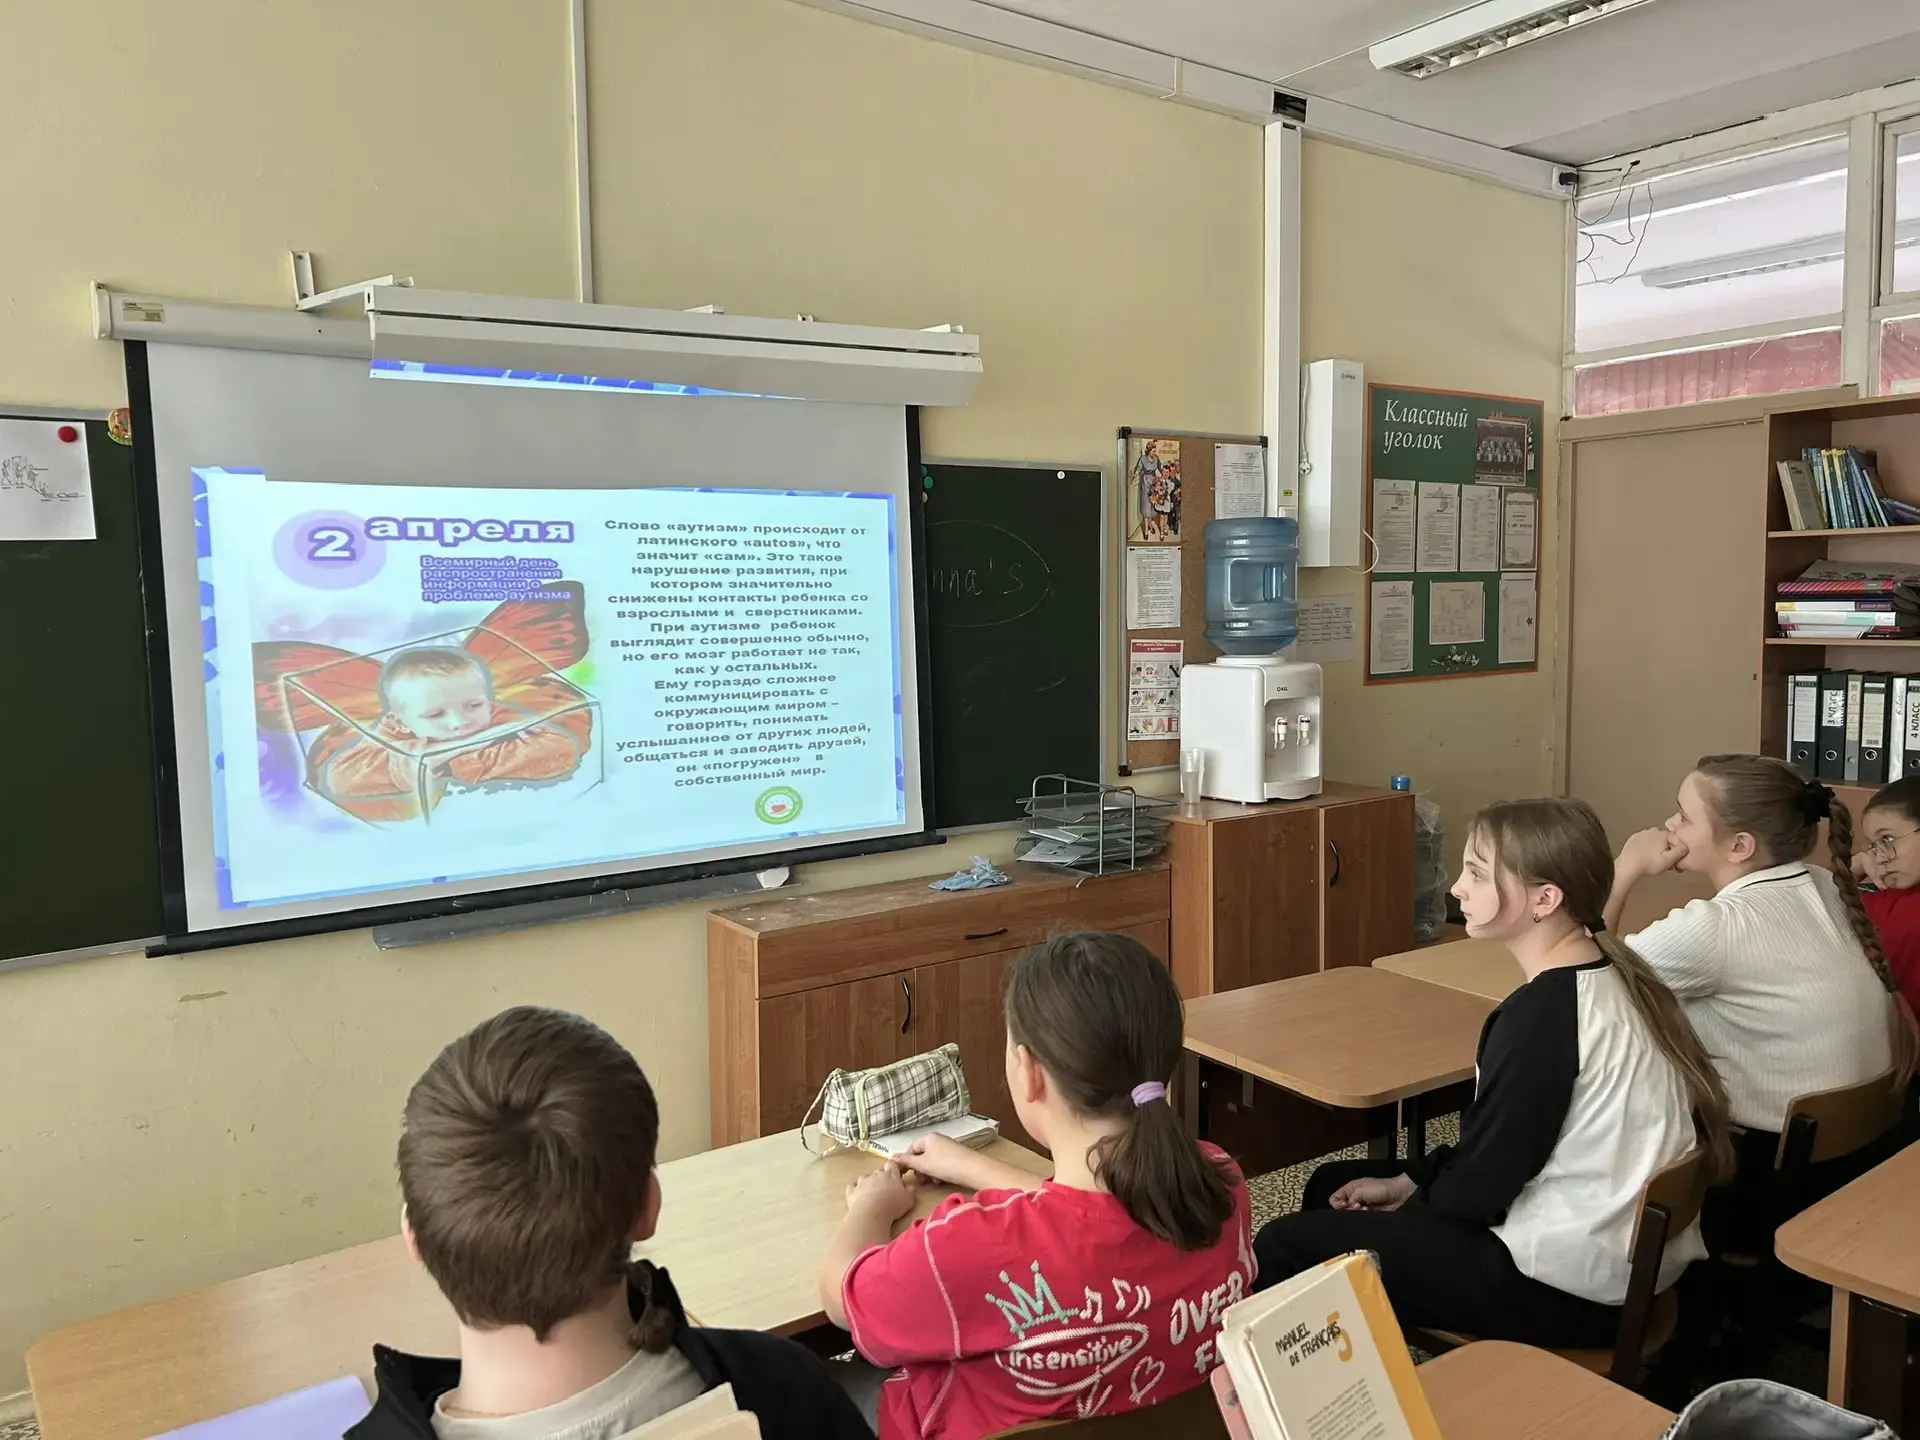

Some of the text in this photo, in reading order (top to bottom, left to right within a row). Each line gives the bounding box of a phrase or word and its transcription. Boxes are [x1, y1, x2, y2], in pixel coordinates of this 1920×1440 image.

[1384, 399, 1468, 428] Классный
[1383, 431, 1443, 454] уголок
[604, 520, 866, 536] Слово «аутизм» происходит от
[310, 519, 573, 559] 2 апреля
[637, 536, 841, 550] латинского «autos», что
[421, 556, 556, 569] Всемирный день
[637, 552, 842, 562] значит «сам». Это такое
[422, 569, 561, 580] распространения
[631, 565, 847, 577] нарушение развития, при
[423, 580, 529, 591] информации
[650, 580, 832, 590] котором значительно
[424, 591, 571, 602] проблеме аутизма
[607, 592, 868, 604] снижены контакты ребенка со
[617, 607, 862, 620] взрослыми и сверстниками.
[650, 620, 836, 634] При аутизме ребенок
[610, 632, 869, 649] выглядит совершенно обычно,
[623, 646, 860, 662] но его мозг работает не так,
[675, 661, 817, 675] как у остальных.
[654, 673, 836, 691] Ему гораздо сложнее
[664, 688, 814, 704] коммуницировать
[654, 704, 770, 718] окружающим
[775, 700, 827, 712] миром
[1911, 702, 1920, 731] КЛАСС
[667, 713, 828, 732] говорить, понимать
[616, 723, 871, 751] услышанное от других людей,
[623, 737, 866, 764] общаться и заводить друзей,
[676, 754, 823, 773] он «погружен» в
[674, 766, 825, 788] собственный мир.
[1170, 1271, 1243, 1345] OVER
[1275, 1322, 1311, 1354] MANUEL
[1289, 1321, 1341, 1367] DE FRANÇAIS
[1326, 1311, 1353, 1362] 5
